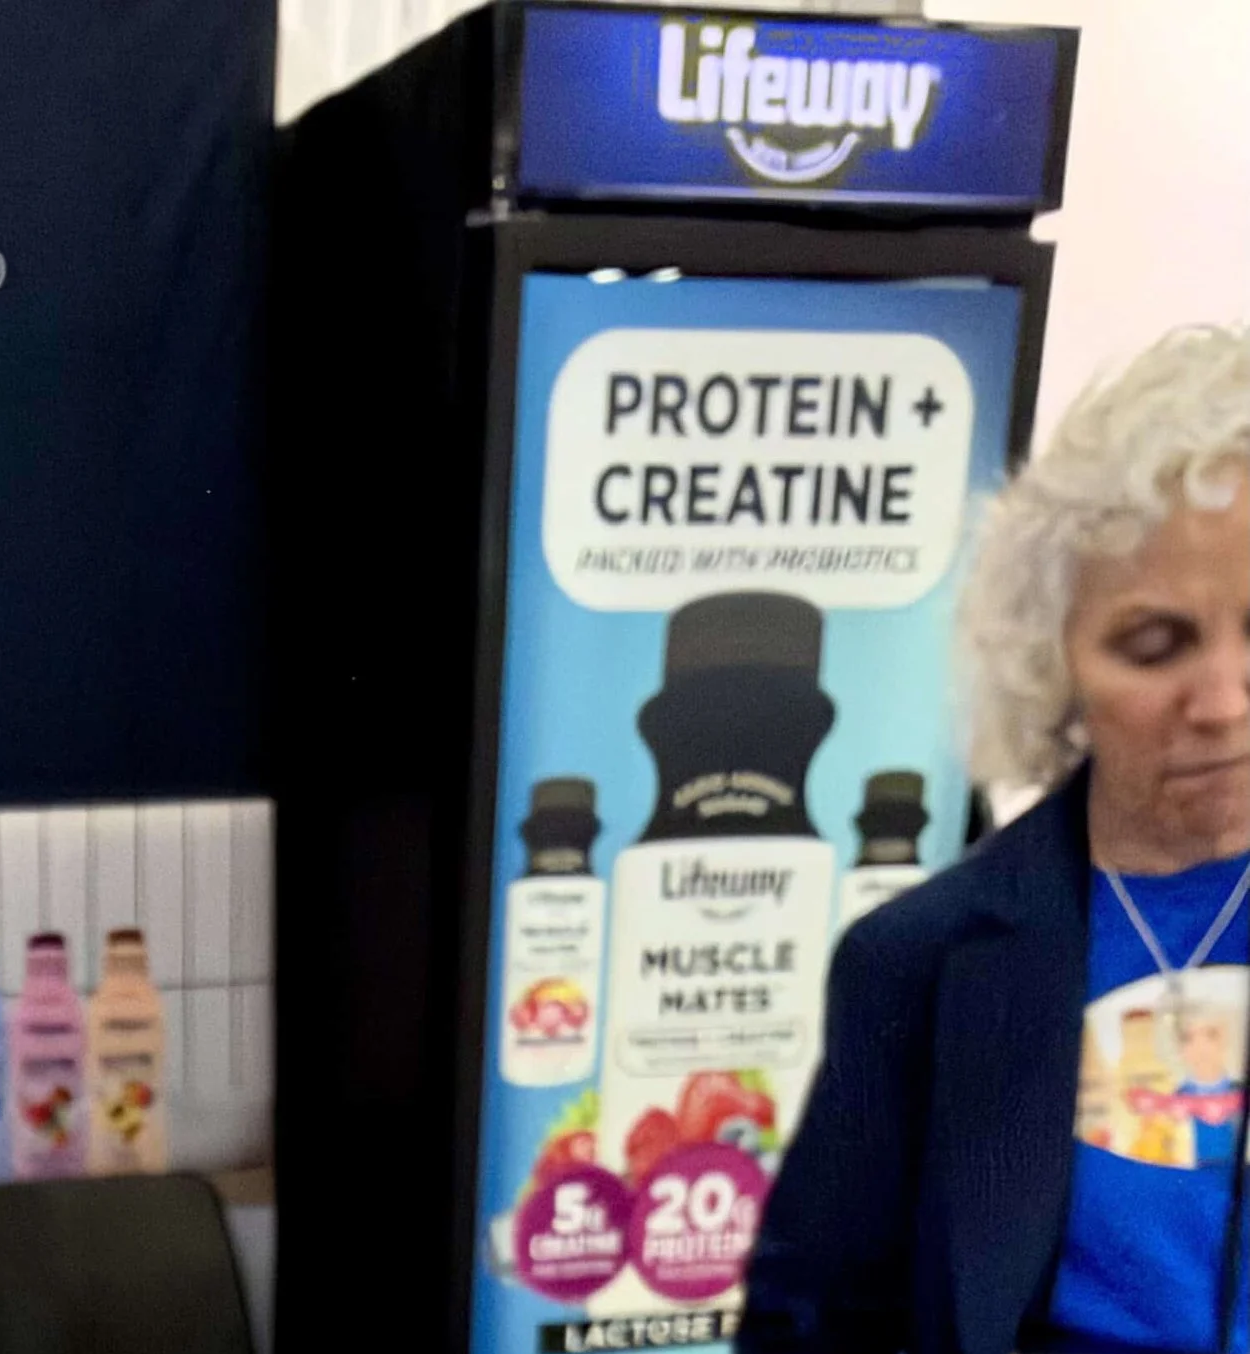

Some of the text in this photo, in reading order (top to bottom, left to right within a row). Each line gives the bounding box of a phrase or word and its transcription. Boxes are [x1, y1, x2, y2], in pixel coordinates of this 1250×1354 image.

[658, 22, 930, 151] Lifeway
[605, 372, 892, 438] PROTEIN
[594, 463, 915, 526] CREATINE
[639, 942, 798, 978] MUSCLE
[564, 1316, 713, 1353] LACTOSE
